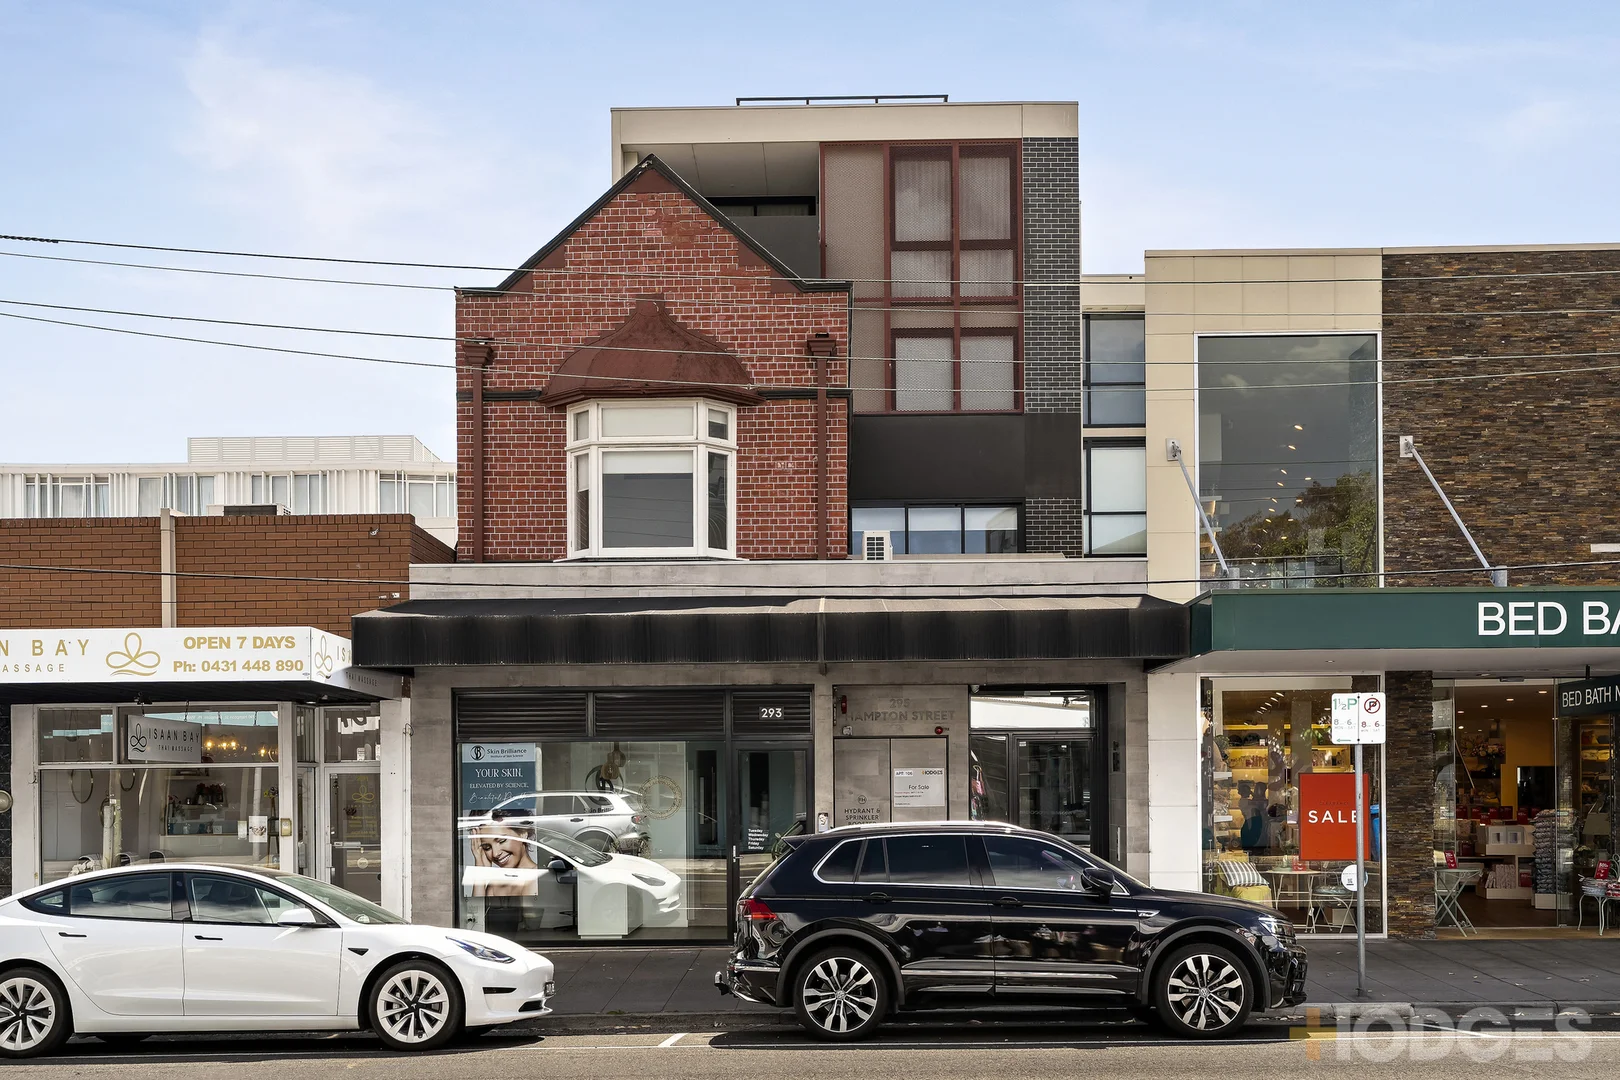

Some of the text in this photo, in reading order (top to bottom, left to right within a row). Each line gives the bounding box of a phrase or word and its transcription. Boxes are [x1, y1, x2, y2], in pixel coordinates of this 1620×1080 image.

[1478, 601, 1568, 636] BED
[31, 639, 89, 656] BAY
[183, 636, 296, 650] OPEN 7 DAYS
[173, 659, 304, 673] Ph: 0431 448 890
[889, 698, 912, 709] 295
[1562, 690, 1582, 708] BED
[1585, 685, 1612, 705] BATH
[761, 707, 782, 718] 293
[845, 710, 956, 722] HAMPTON STREET
[148, 727, 200, 744] ISAAN BAY
[475, 768, 499, 778] YOUR
[1308, 810, 1357, 824] SALE
